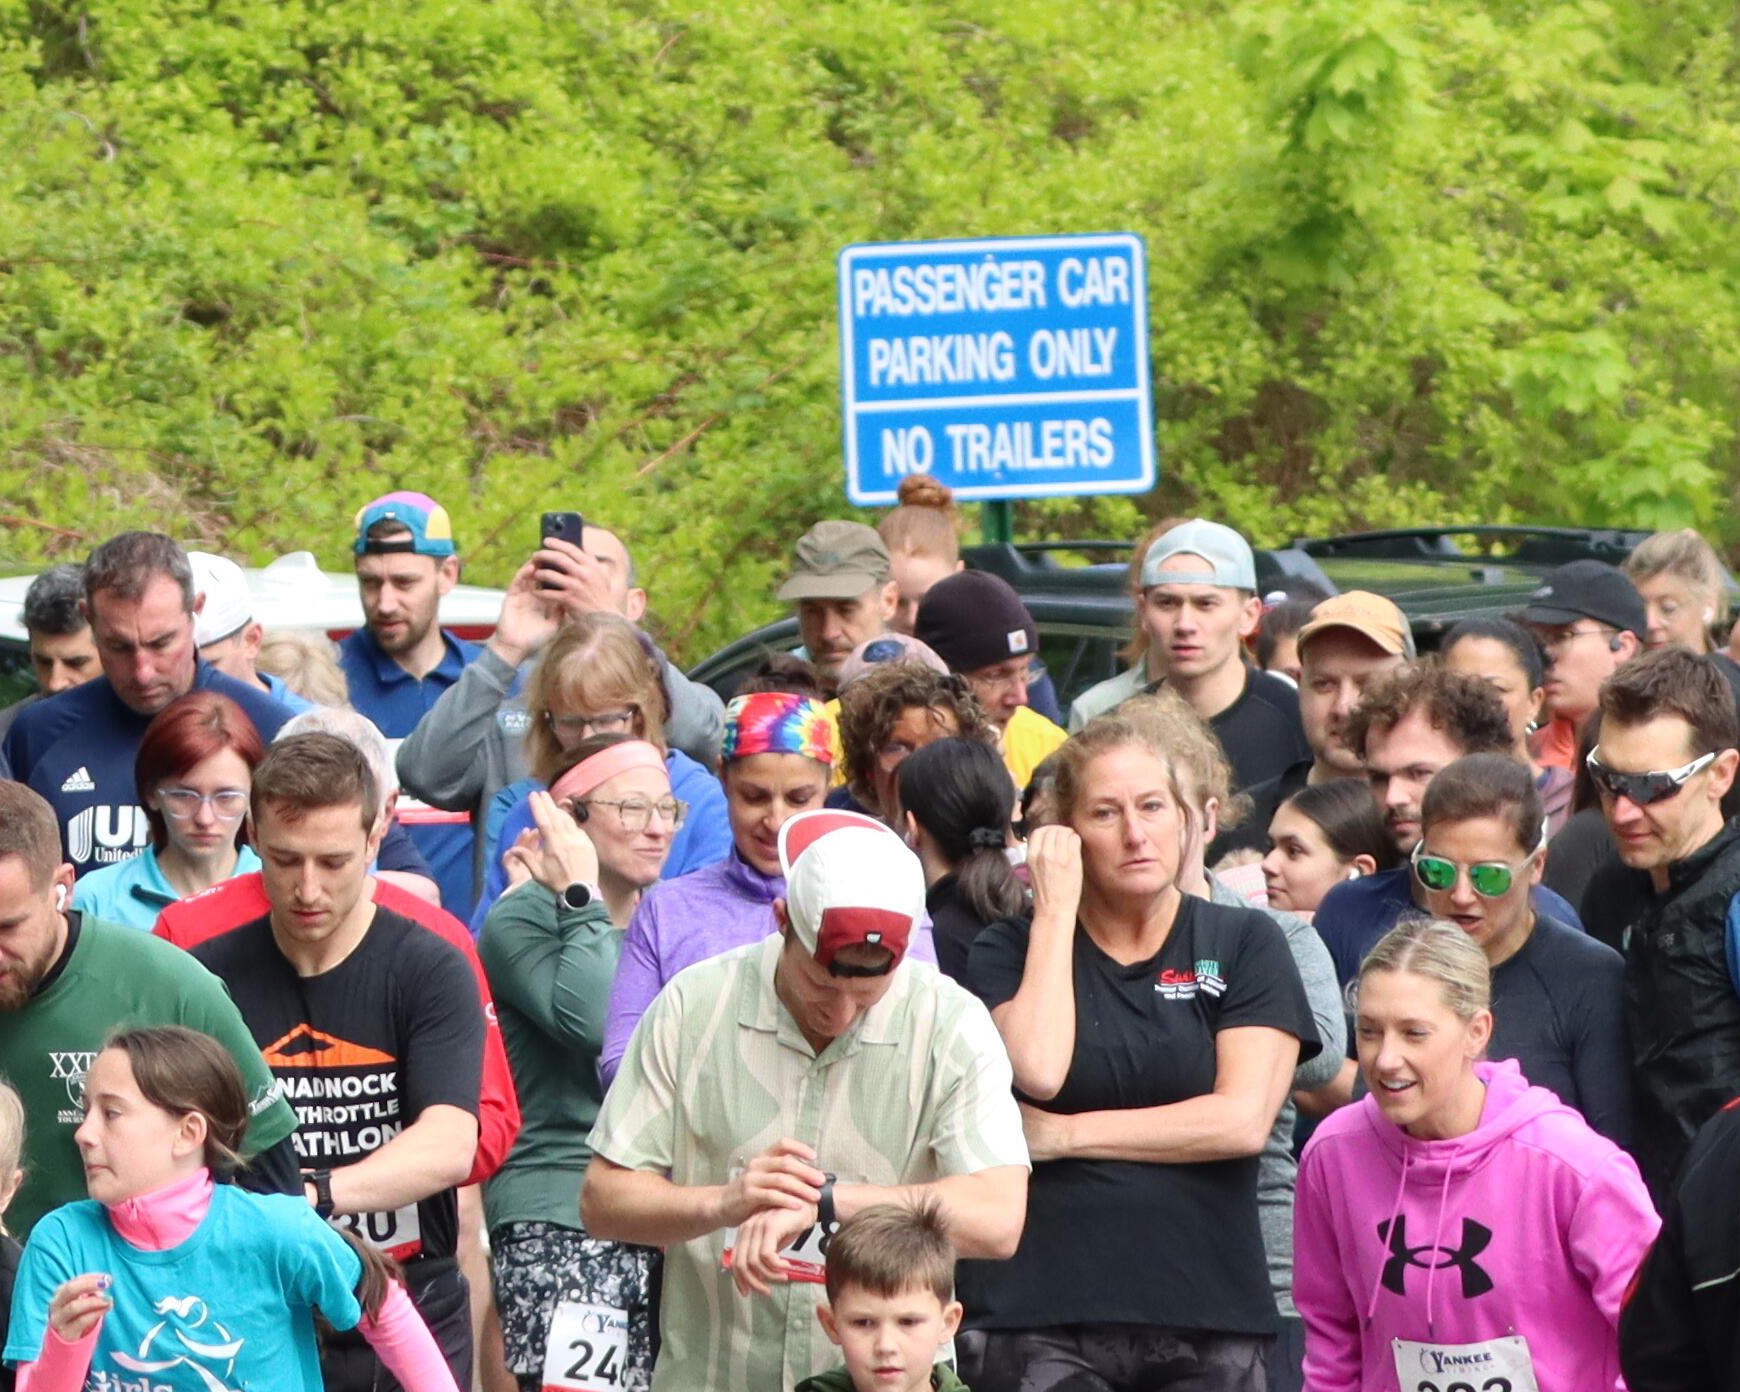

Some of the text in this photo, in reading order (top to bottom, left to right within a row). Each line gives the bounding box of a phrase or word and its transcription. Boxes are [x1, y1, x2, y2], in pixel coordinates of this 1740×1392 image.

[854, 257, 1130, 317] PASSENGER CAR
[869, 326, 1119, 386] PARKING ONLY
[882, 417, 1115, 475] NO TRAILERS
[279, 1072, 397, 1099] NADNOCK
[298, 1098, 400, 1124] THROTTLE
[292, 1120, 402, 1157] ATHLON
[1432, 1350, 1494, 1374] YANKEE
